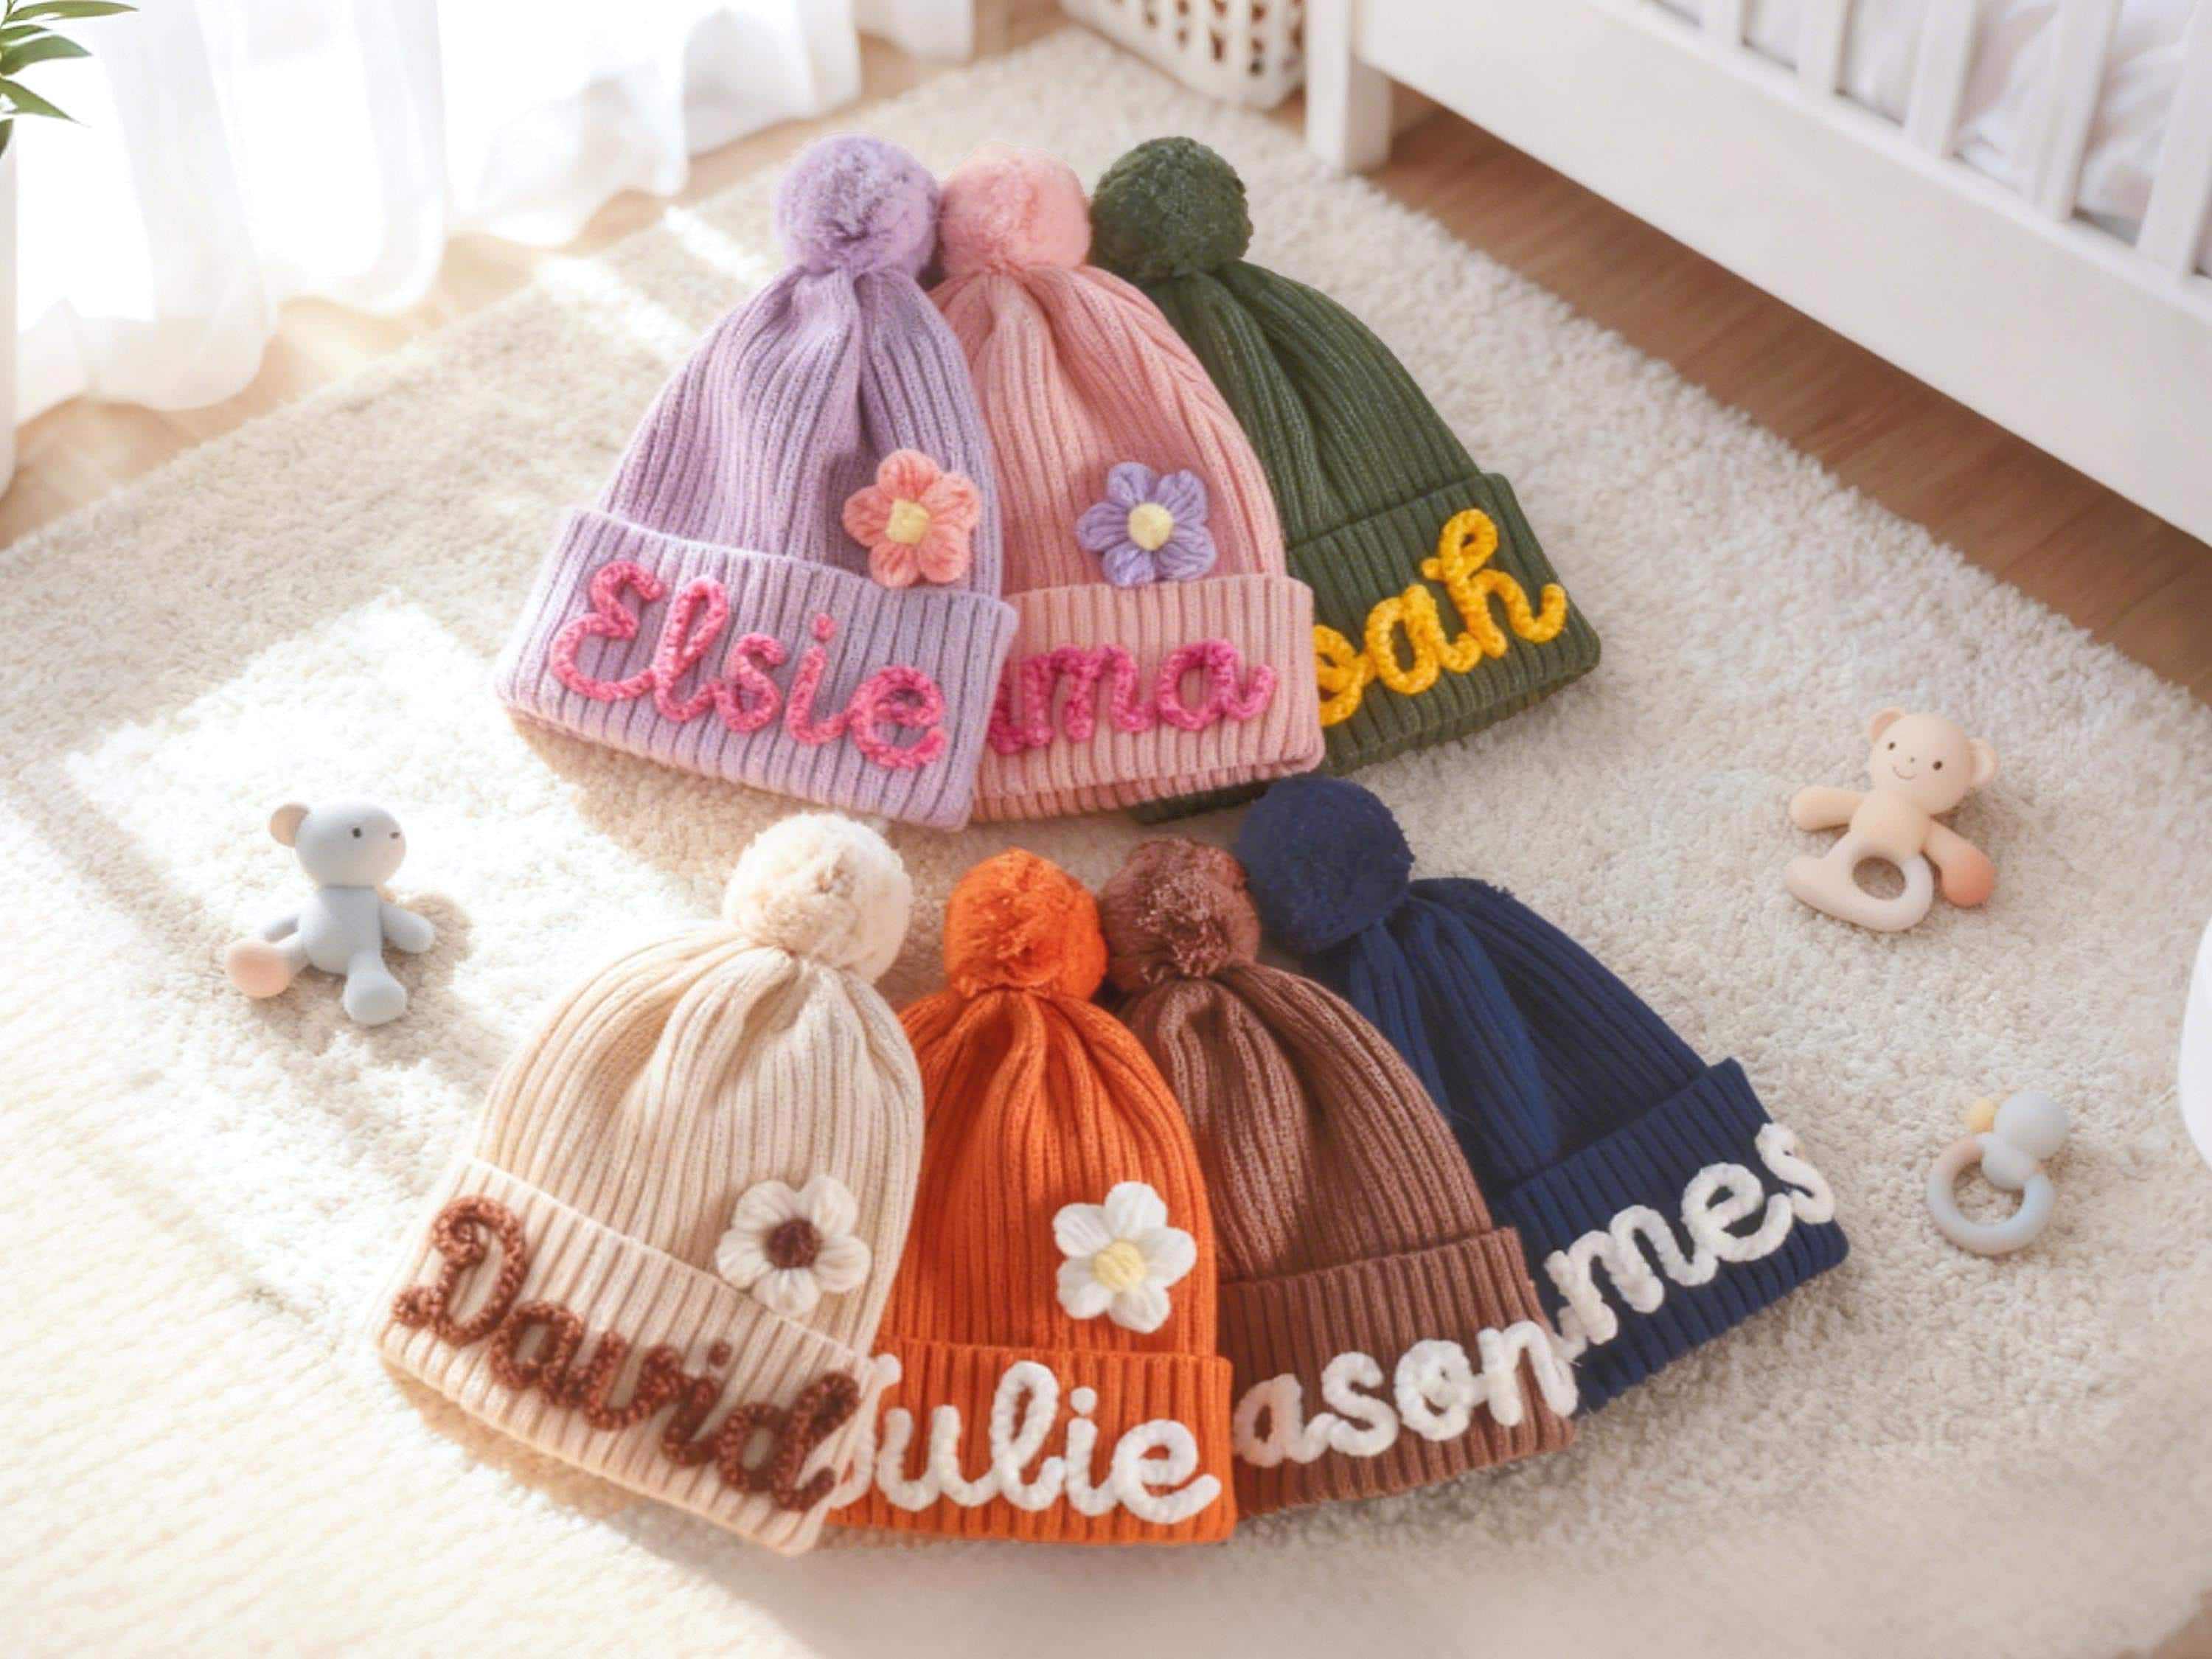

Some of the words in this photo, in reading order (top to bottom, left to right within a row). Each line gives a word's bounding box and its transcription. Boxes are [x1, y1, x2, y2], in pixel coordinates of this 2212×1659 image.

[550, 560, 947, 769] Elsie
[986, 639, 1277, 755] ma
[392, 1194, 860, 1512] David
[1544, 1122, 1835, 1363] mes
